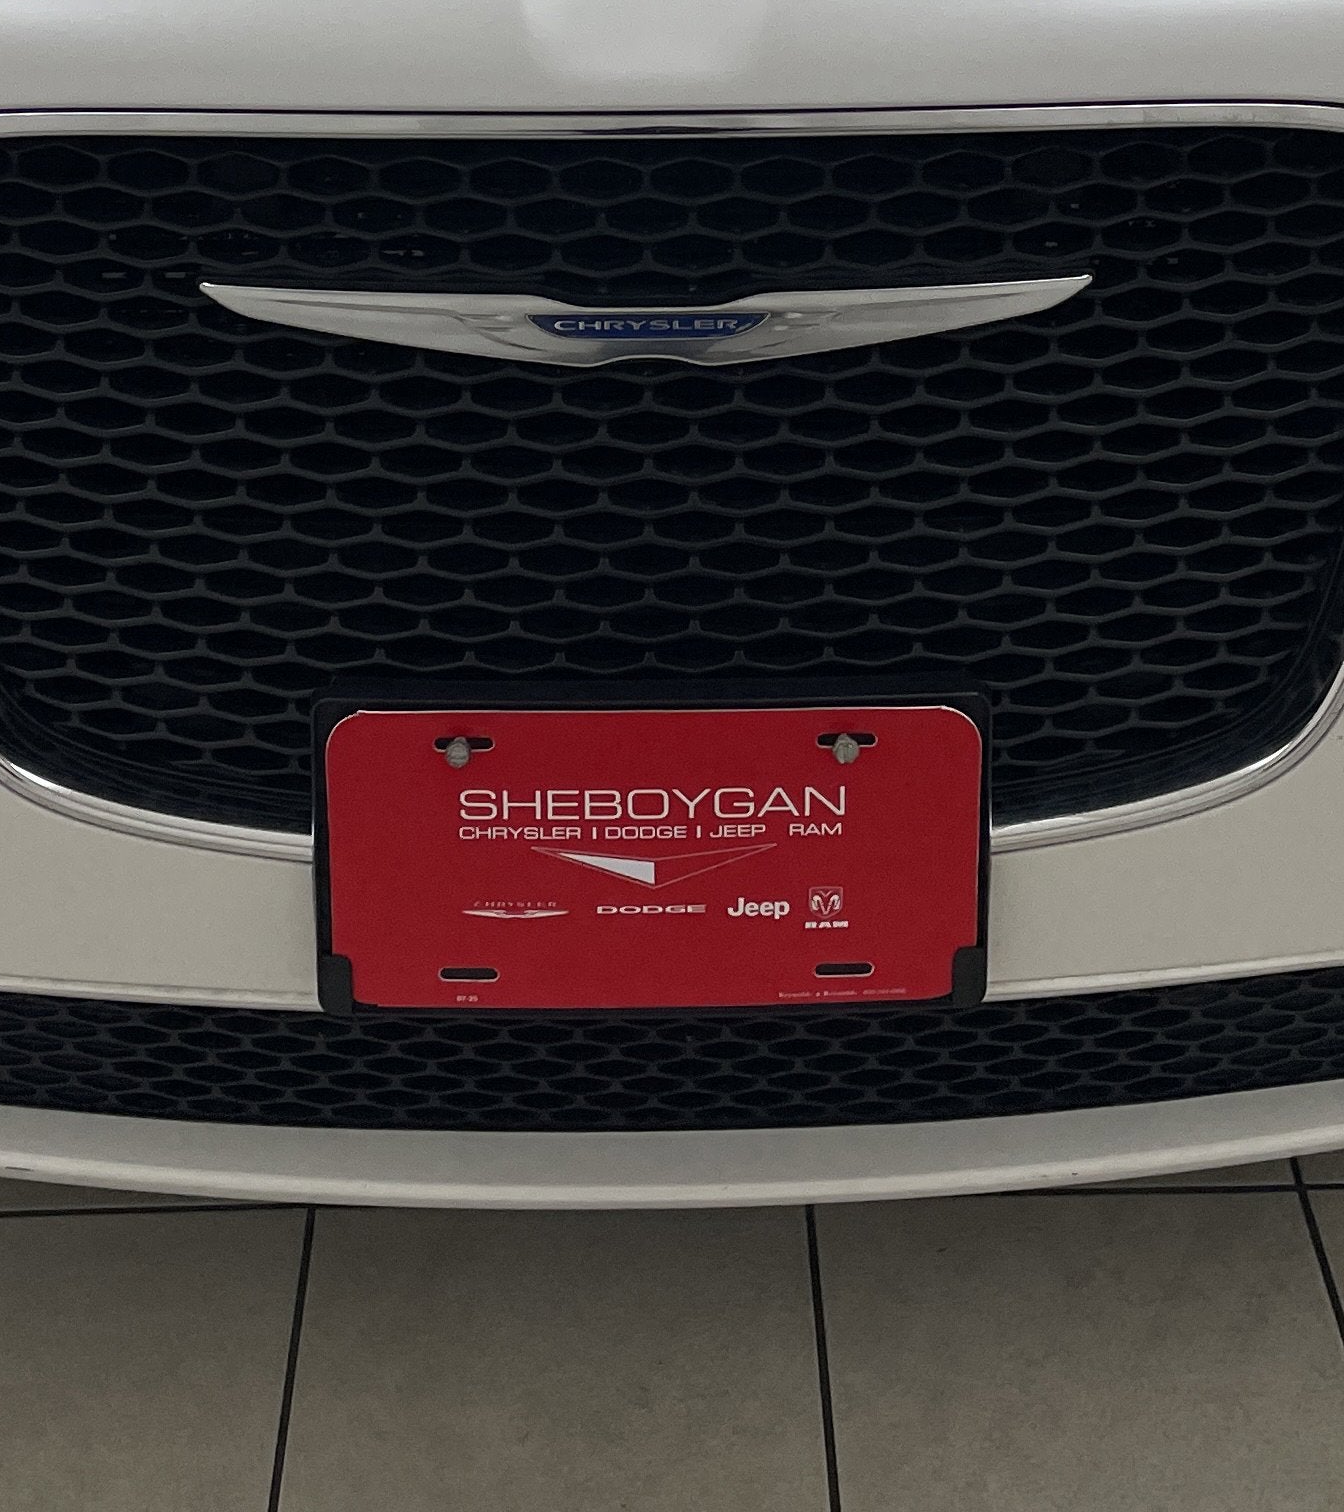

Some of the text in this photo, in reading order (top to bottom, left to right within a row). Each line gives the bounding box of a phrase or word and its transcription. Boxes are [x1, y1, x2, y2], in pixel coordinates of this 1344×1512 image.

[554, 318, 739, 332] CHRYSLER
[458, 785, 847, 821] SHEBOYGAN
[458, 826, 581, 840] CHRYSLER
[604, 825, 687, 839] DODGE
[709, 824, 766, 838] JEEP
[789, 823, 843, 836] RAM
[596, 904, 707, 915] DODGE
[727, 896, 790, 920] Jeep
[804, 920, 849, 929] RAM
